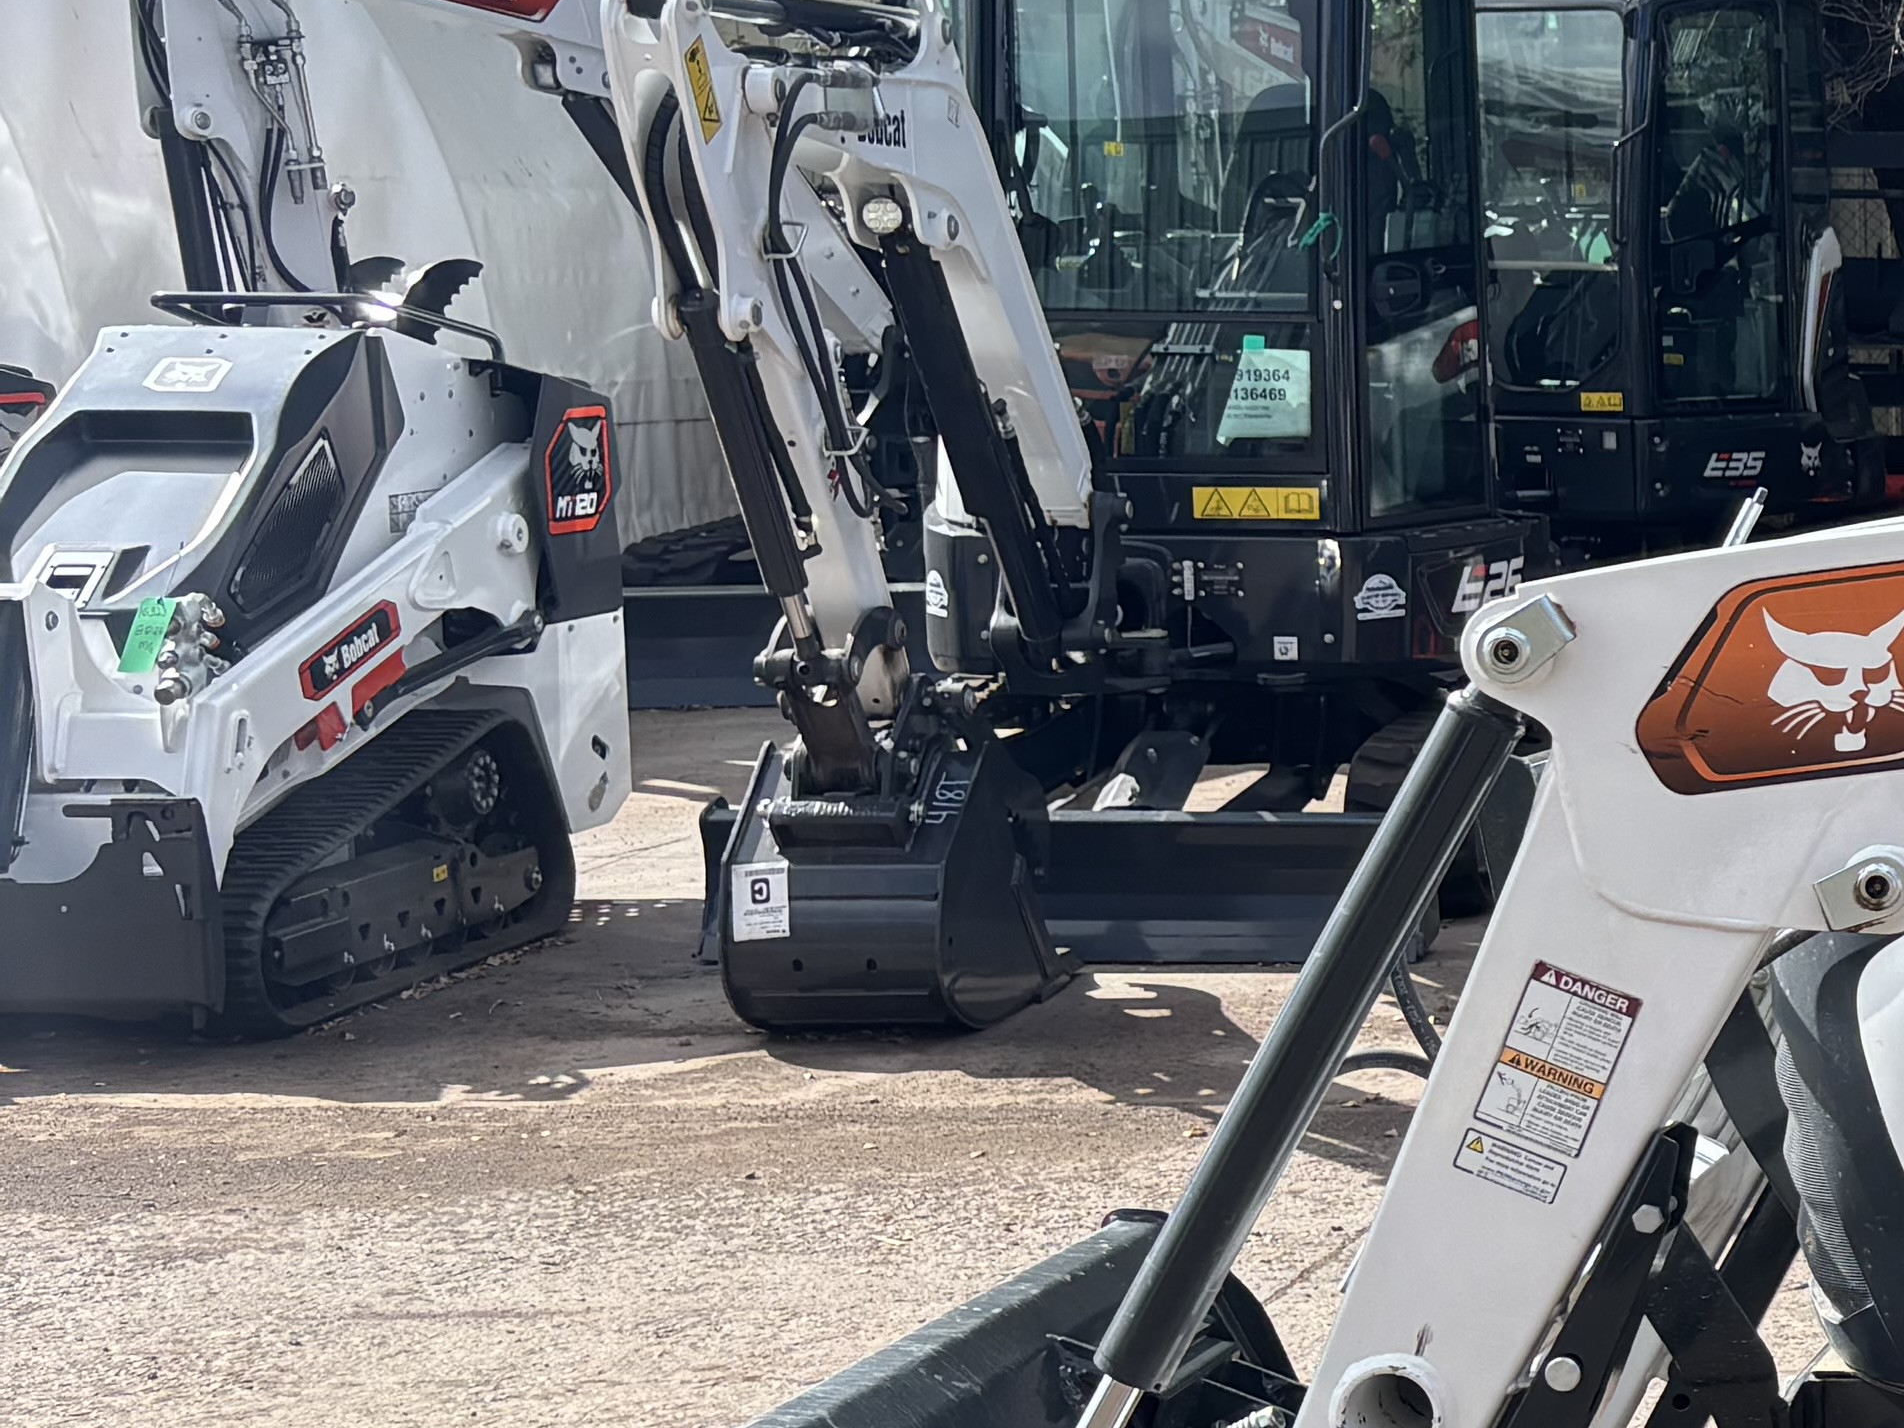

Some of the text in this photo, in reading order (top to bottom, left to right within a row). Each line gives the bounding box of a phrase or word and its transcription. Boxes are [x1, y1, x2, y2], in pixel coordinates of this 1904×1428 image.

[1703, 451, 1766, 477] E35
[556, 491, 598, 518] MT120
[1451, 554, 1525, 613] E26
[340, 622, 380, 669] Bobcat
[1559, 976, 1629, 1012] DANGER
[1524, 1057, 1595, 1094] WARNING
